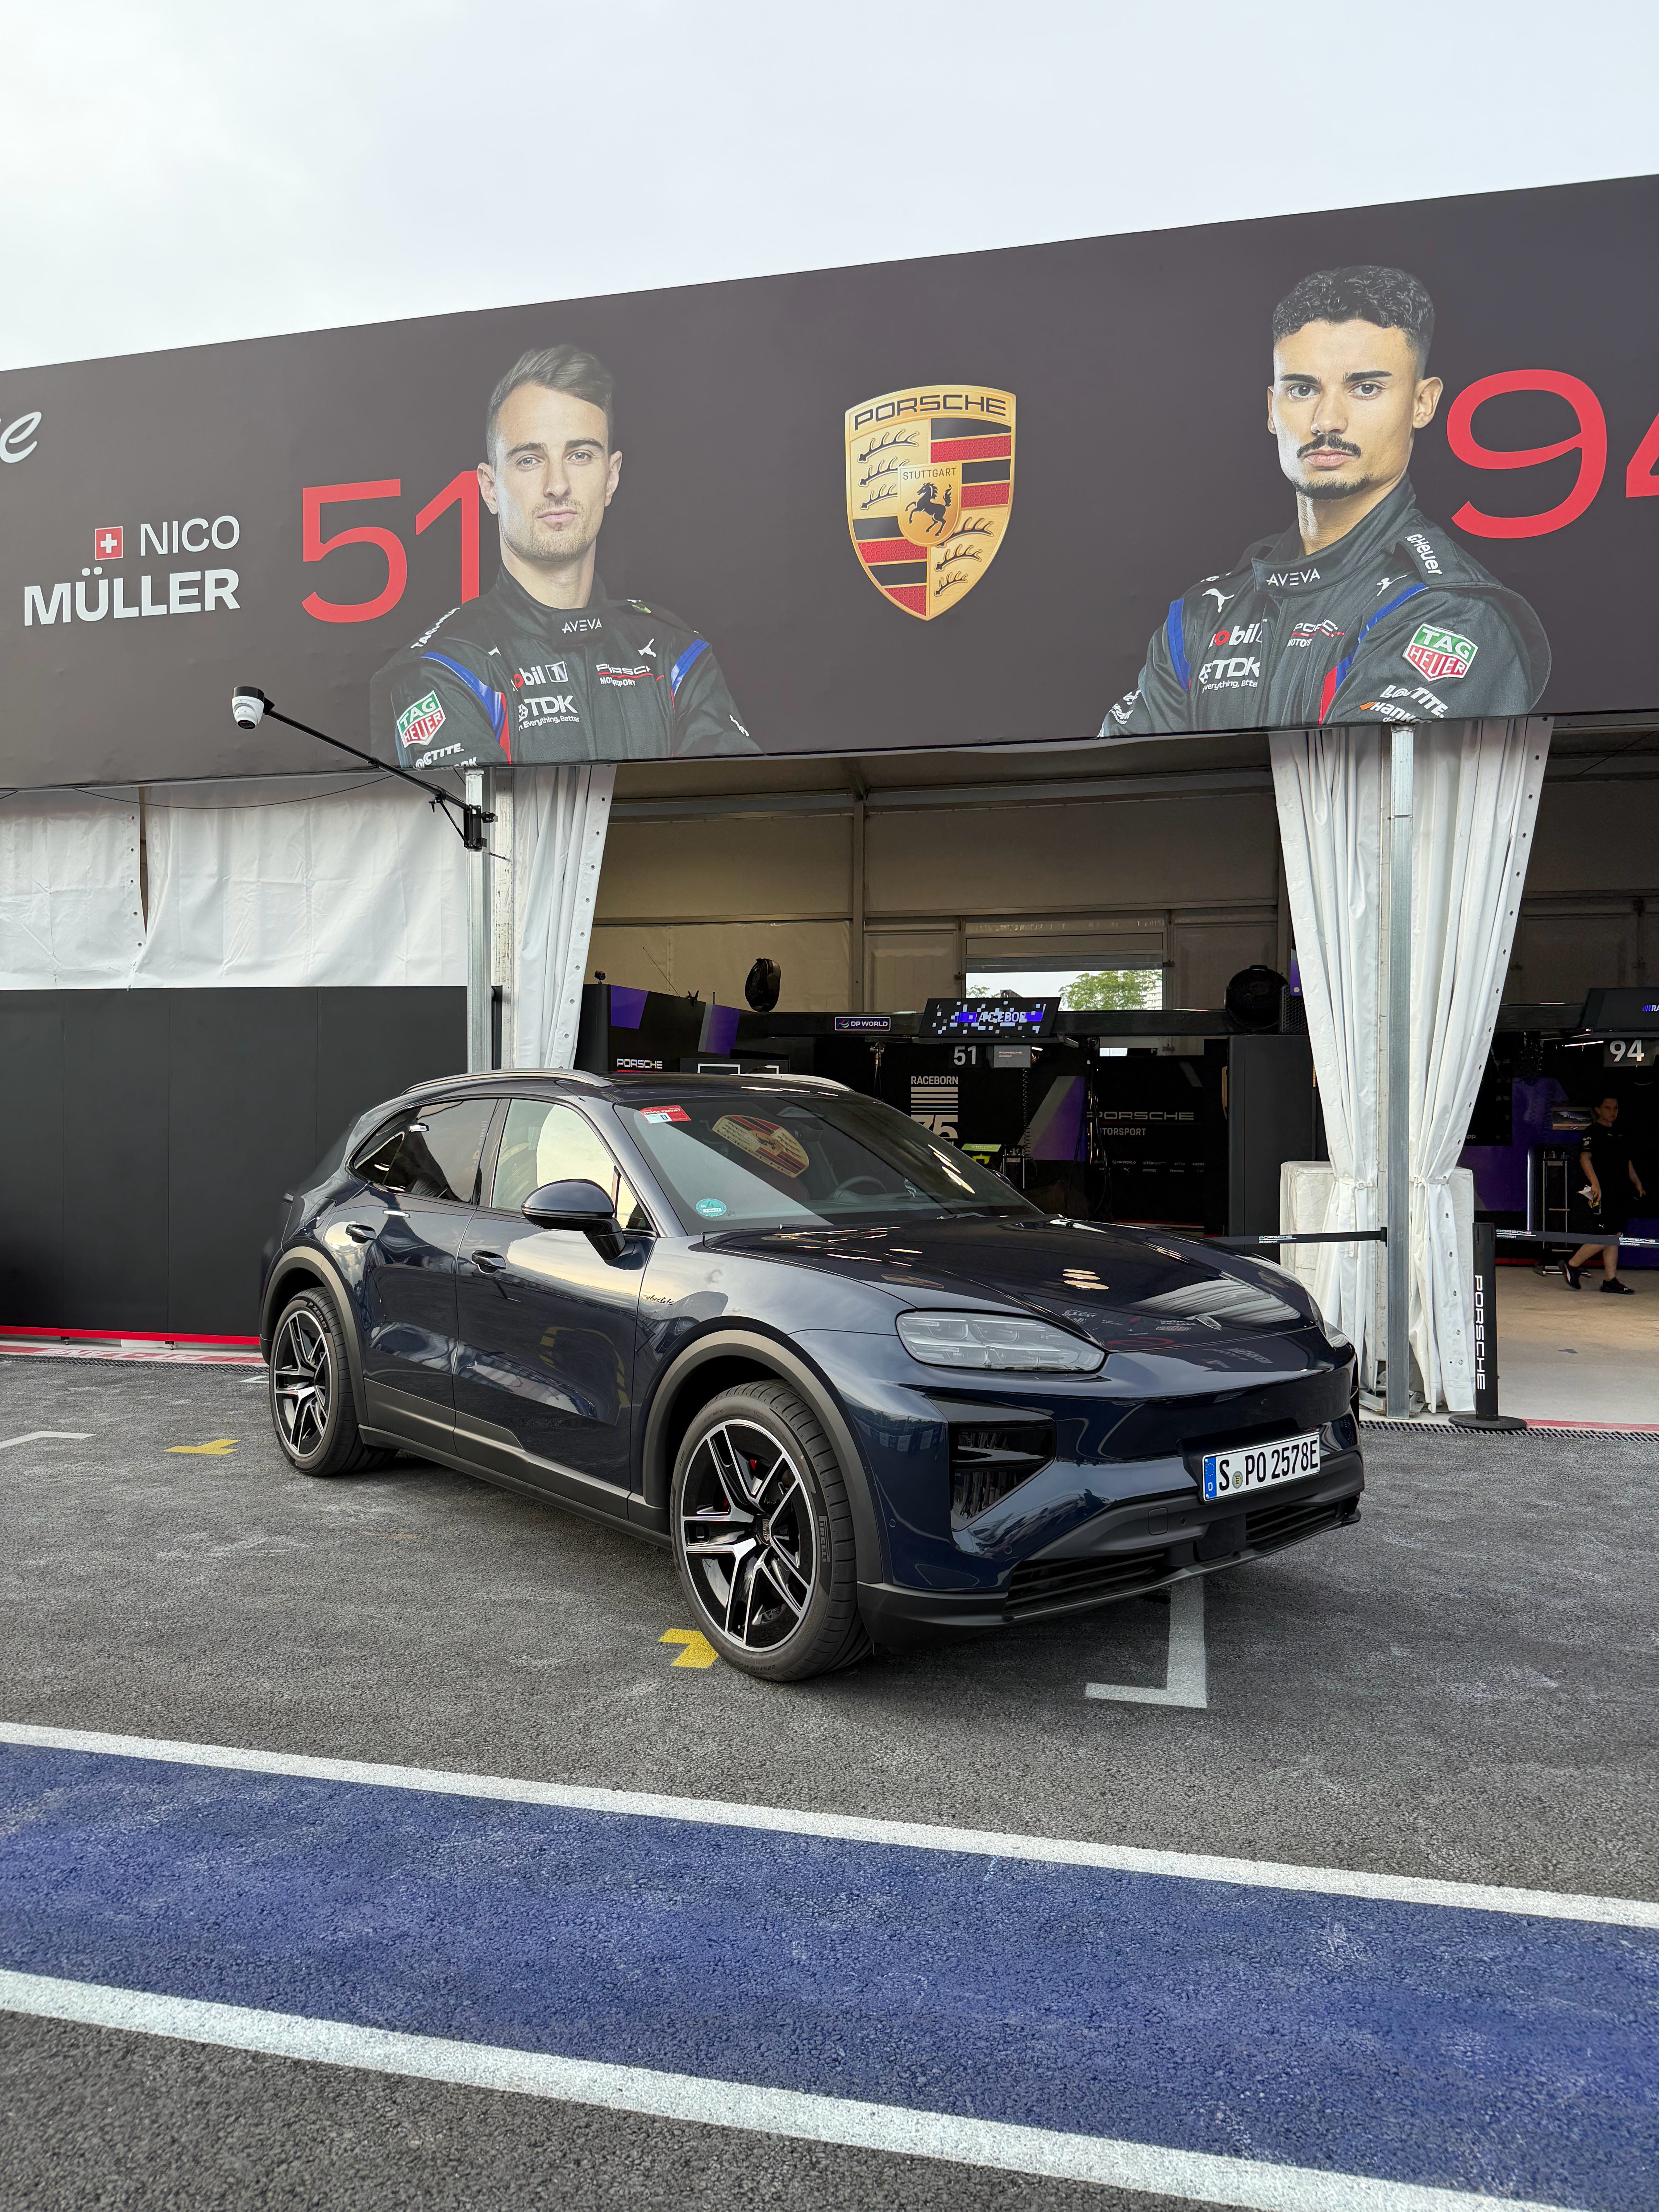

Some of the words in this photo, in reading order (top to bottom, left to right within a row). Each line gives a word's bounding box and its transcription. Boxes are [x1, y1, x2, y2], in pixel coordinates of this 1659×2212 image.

[854, 394, 1006, 431] PORSCHE
[0, 411, 42, 464] e
[1447, 369, 1659, 539] 9
[903, 467, 957, 480] STUTTGART
[140, 515, 240, 556] NICO
[301, 470, 480, 623] 51
[1266, 568, 1321, 586] AVEVA
[24, 567, 240, 626] MÜLLER
[562, 618, 602, 634] AVEVA
[1422, 628, 1472, 659] TAG
[1409, 647, 1466, 677] HEUER
[511, 666, 546, 691] obil
[1202, 680, 1239, 694] verything,
[399, 697, 436, 728] TAG
[524, 695, 578, 716] TDK
[403, 711, 442, 743] HEUER
[523, 716, 560, 728] Everything,
[953, 1046, 976, 1065] 51
[1609, 1040, 1645, 1062] 94
[617, 1058, 663, 1070] PORSCHE
[910, 1076, 958, 1085] RACEBORN
[1100, 1127, 1147, 1136] TORSPORT
[1475, 1275, 1486, 1390] PORSCHE
[1219, 1459, 1230, 1491] S
[1245, 1451, 1266, 1486] PO
[1271, 1439, 1318, 1480] 2578E
[1208, 1482, 1213, 1491] D
